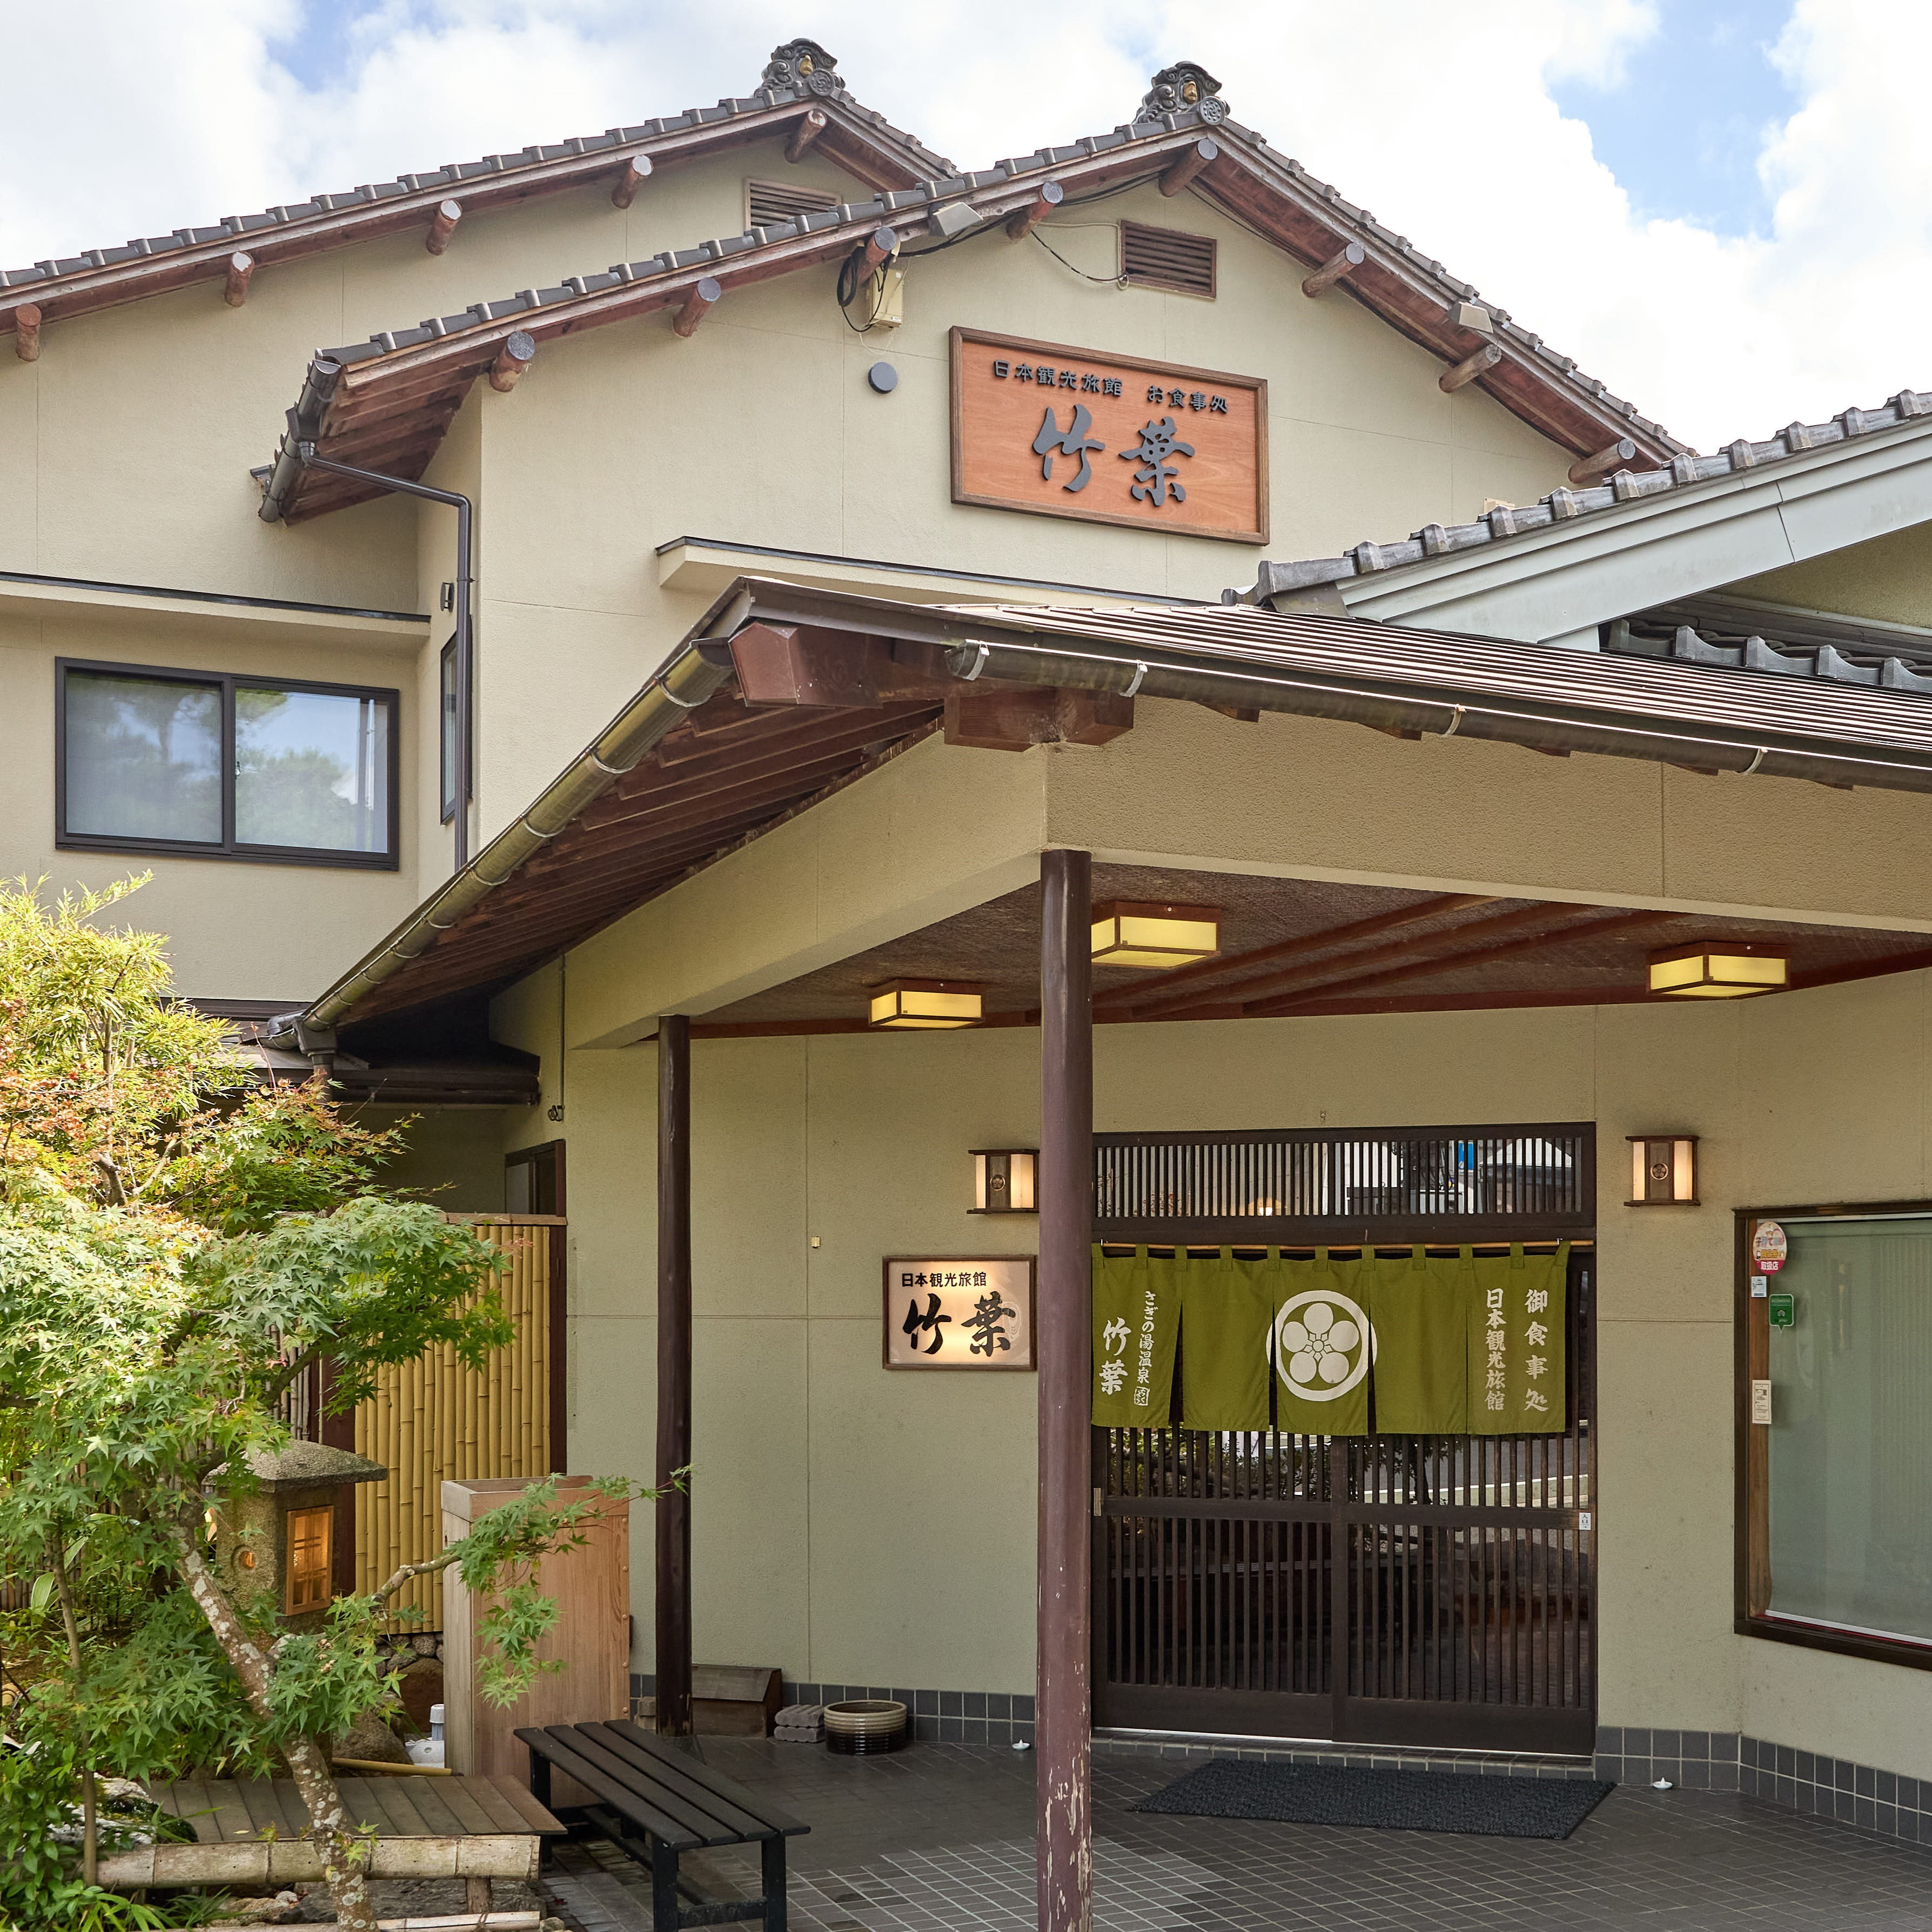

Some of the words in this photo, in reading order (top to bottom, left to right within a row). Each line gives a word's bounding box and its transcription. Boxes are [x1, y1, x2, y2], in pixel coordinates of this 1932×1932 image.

[994, 359, 1123, 398] 日本観光旅館
[1148, 385, 1229, 414] お食事処
[1032, 404, 1195, 507] 竹葉
[901, 1271, 987, 1287] 日本観光旅館
[902, 1290, 1016, 1357] 竹葉
[1098, 1316, 1132, 1396] 竹葉
[1137, 1290, 1158, 1384] さぎの湯温泉
[1485, 1287, 1507, 1411] 日本観光旅館
[1524, 1289, 1549, 1412] 御食事処
